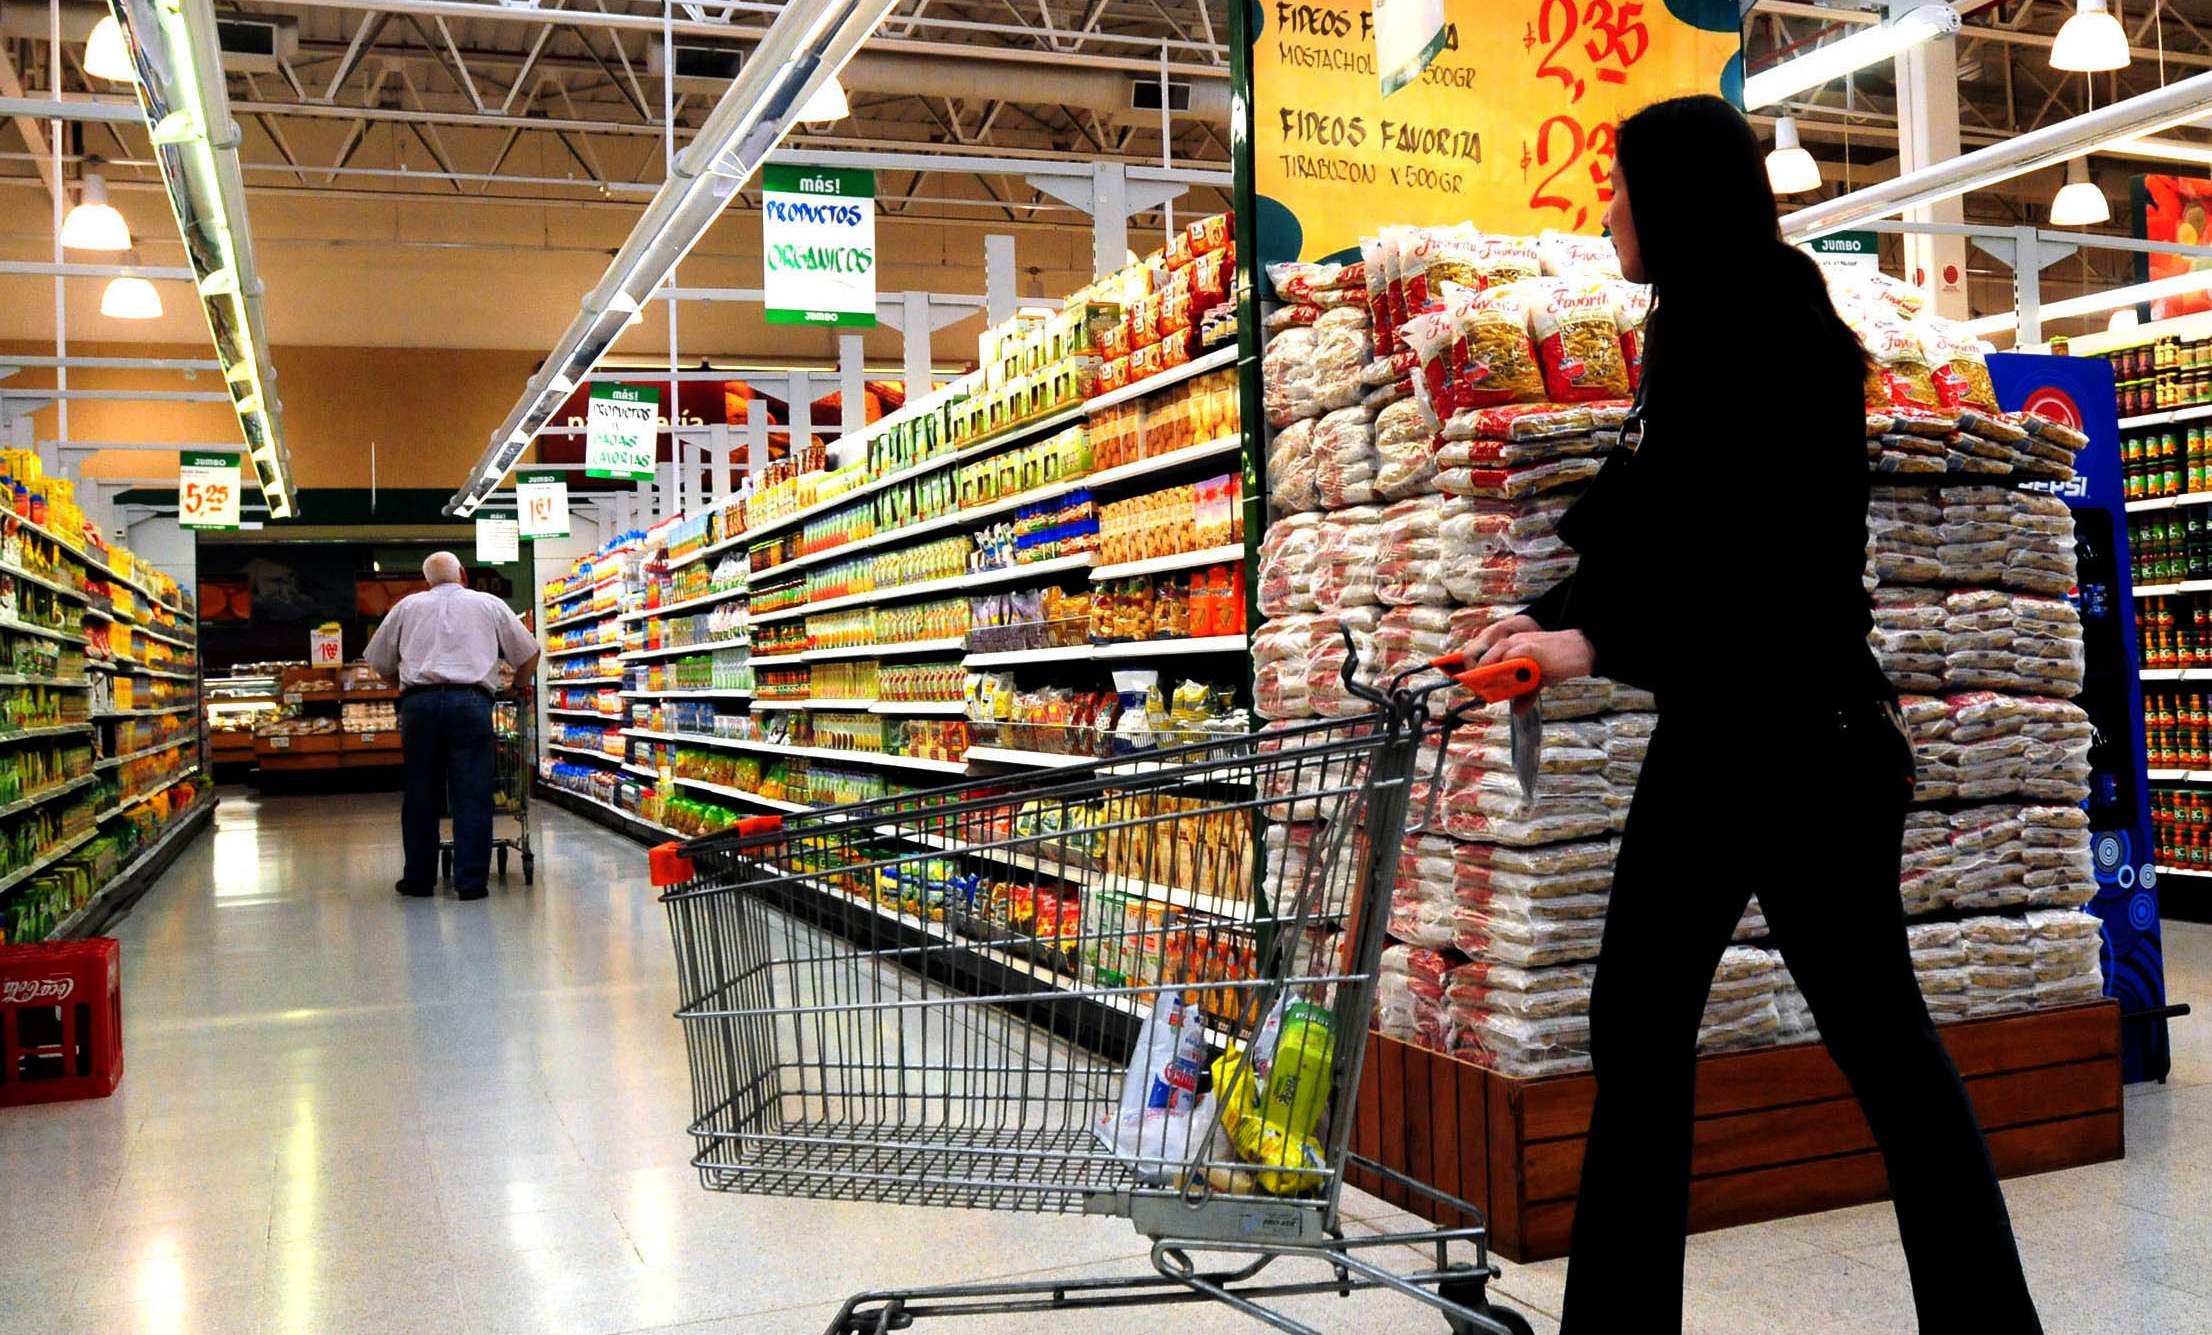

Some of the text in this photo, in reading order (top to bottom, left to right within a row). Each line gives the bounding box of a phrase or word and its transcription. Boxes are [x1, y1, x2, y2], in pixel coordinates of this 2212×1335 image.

[1276, 1, 1352, 38] FIDEOS
[1279, 41, 1376, 75] MOSTACHOL
[1280, 107, 1482, 164] FIDEOS FAVORITA
[1280, 154, 1376, 184] TIRABUZON
[767, 201, 862, 226] PRODUCTOS
[768, 244, 872, 273] ORGANICOS
[1822, 240, 1861, 251] JUMBO
[1547, 288, 1607, 315] Favorit
[804, 311, 838, 322] JUMBO
[194, 458, 227, 466] JUMBO
[528, 475, 555, 483] JUMBO
